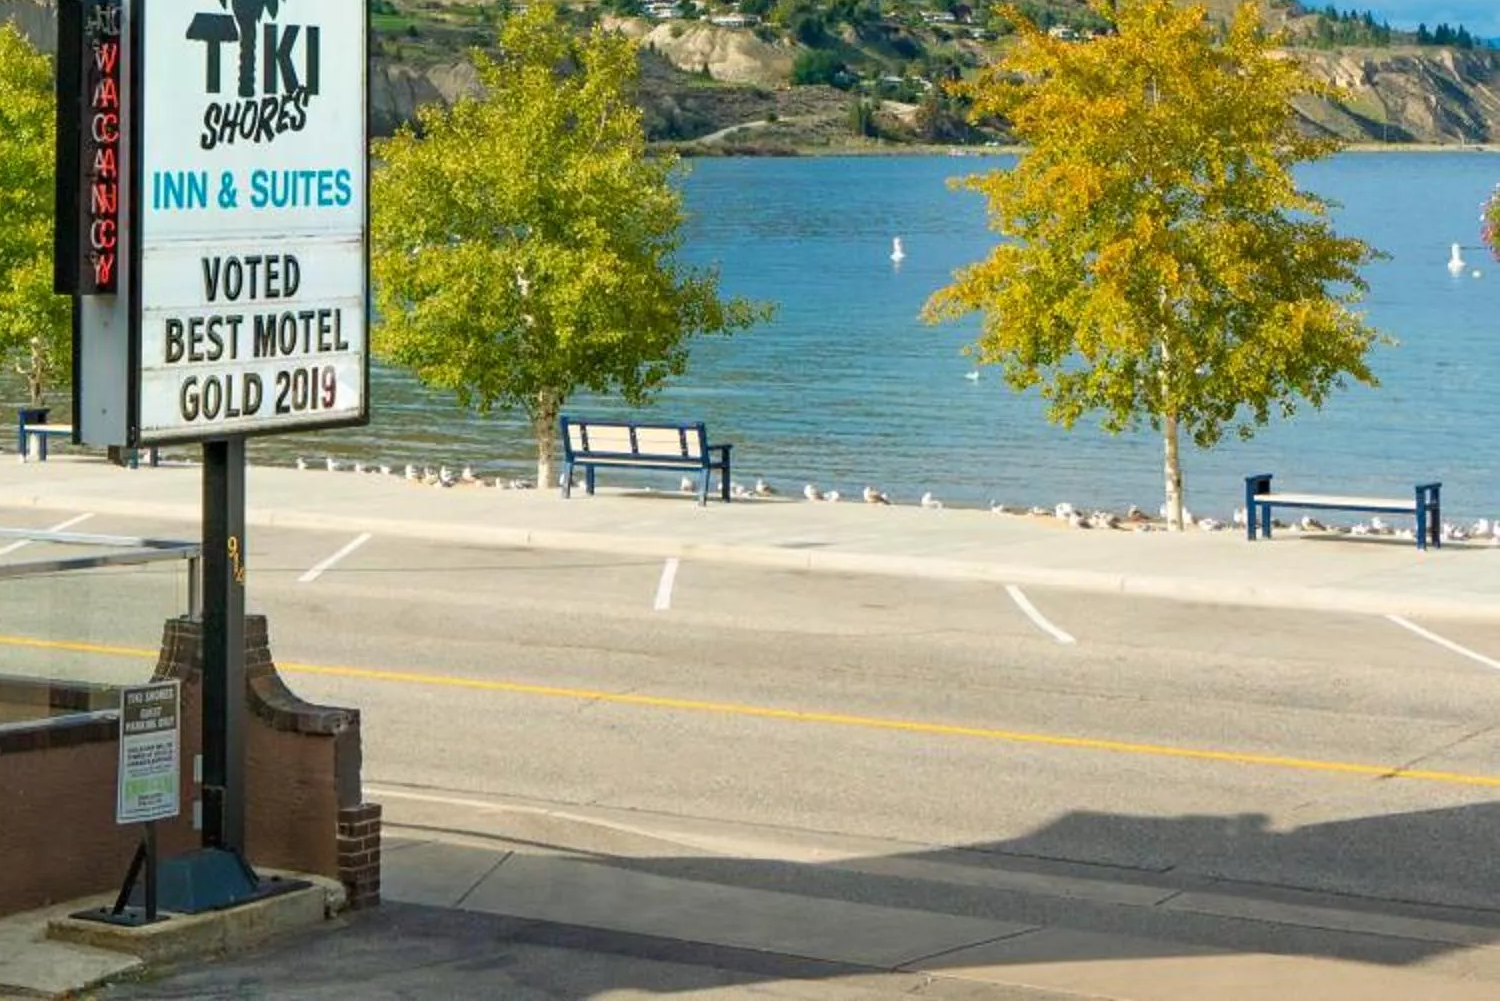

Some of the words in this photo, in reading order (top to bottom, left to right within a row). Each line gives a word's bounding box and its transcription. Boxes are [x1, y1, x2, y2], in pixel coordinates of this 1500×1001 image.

[185, 12, 320, 97] TIKI
[200, 85, 309, 150] SHORES
[93, 42, 118, 285] VACANCY
[153, 171, 208, 209] INN
[218, 171, 238, 209] &
[250, 169, 352, 208] SUITES
[201, 254, 301, 302] VOTED
[165, 314, 243, 363] BEST
[253, 308, 349, 358] MOTEL
[180, 372, 263, 422] GOLD
[275, 364, 336, 415] 2019
